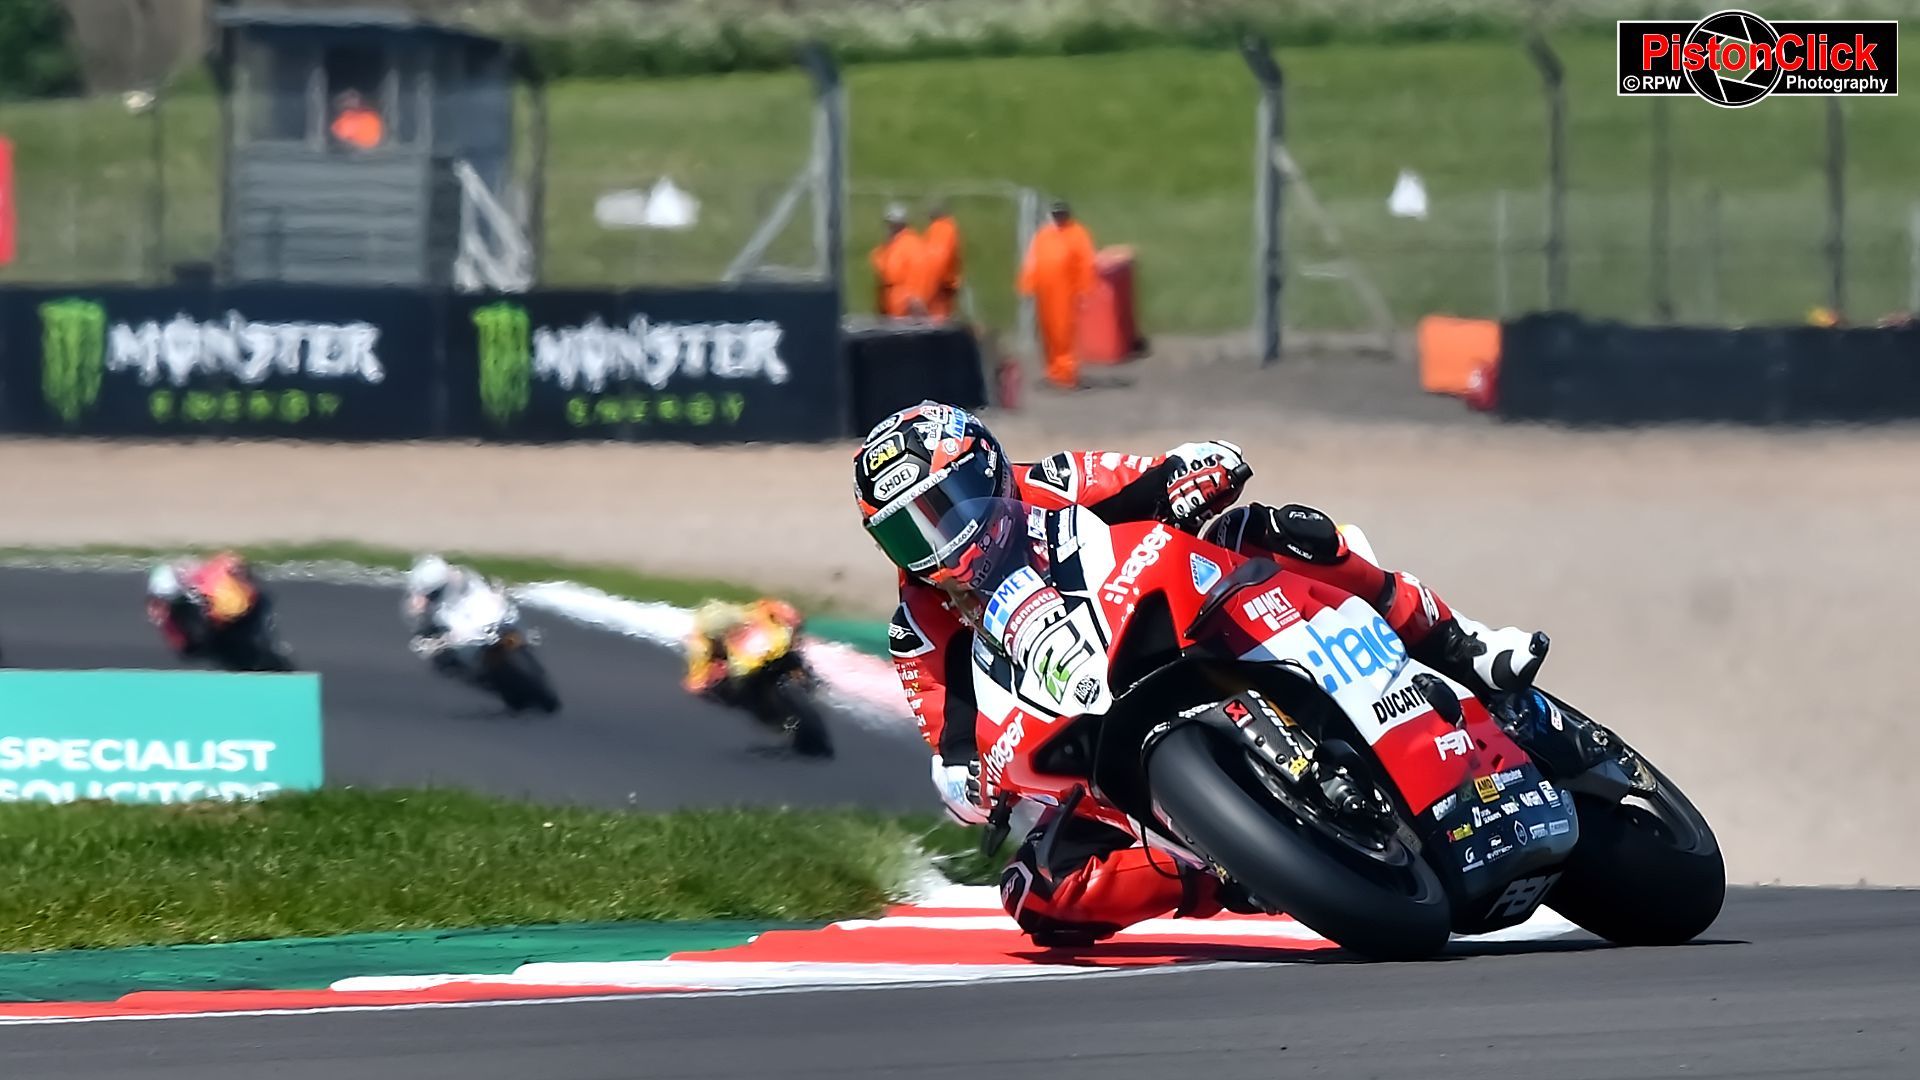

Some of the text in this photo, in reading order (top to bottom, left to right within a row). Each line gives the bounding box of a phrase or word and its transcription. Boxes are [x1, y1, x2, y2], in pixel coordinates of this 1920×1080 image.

[107, 309, 385, 387] MONSTER
[532, 312, 789, 393] MONSTER
[879, 468, 912, 496] SHOEI
[997, 569, 1035, 604] MET
[1010, 591, 1056, 633] Bennetts
[0, 735, 277, 772] SPECIALIST
